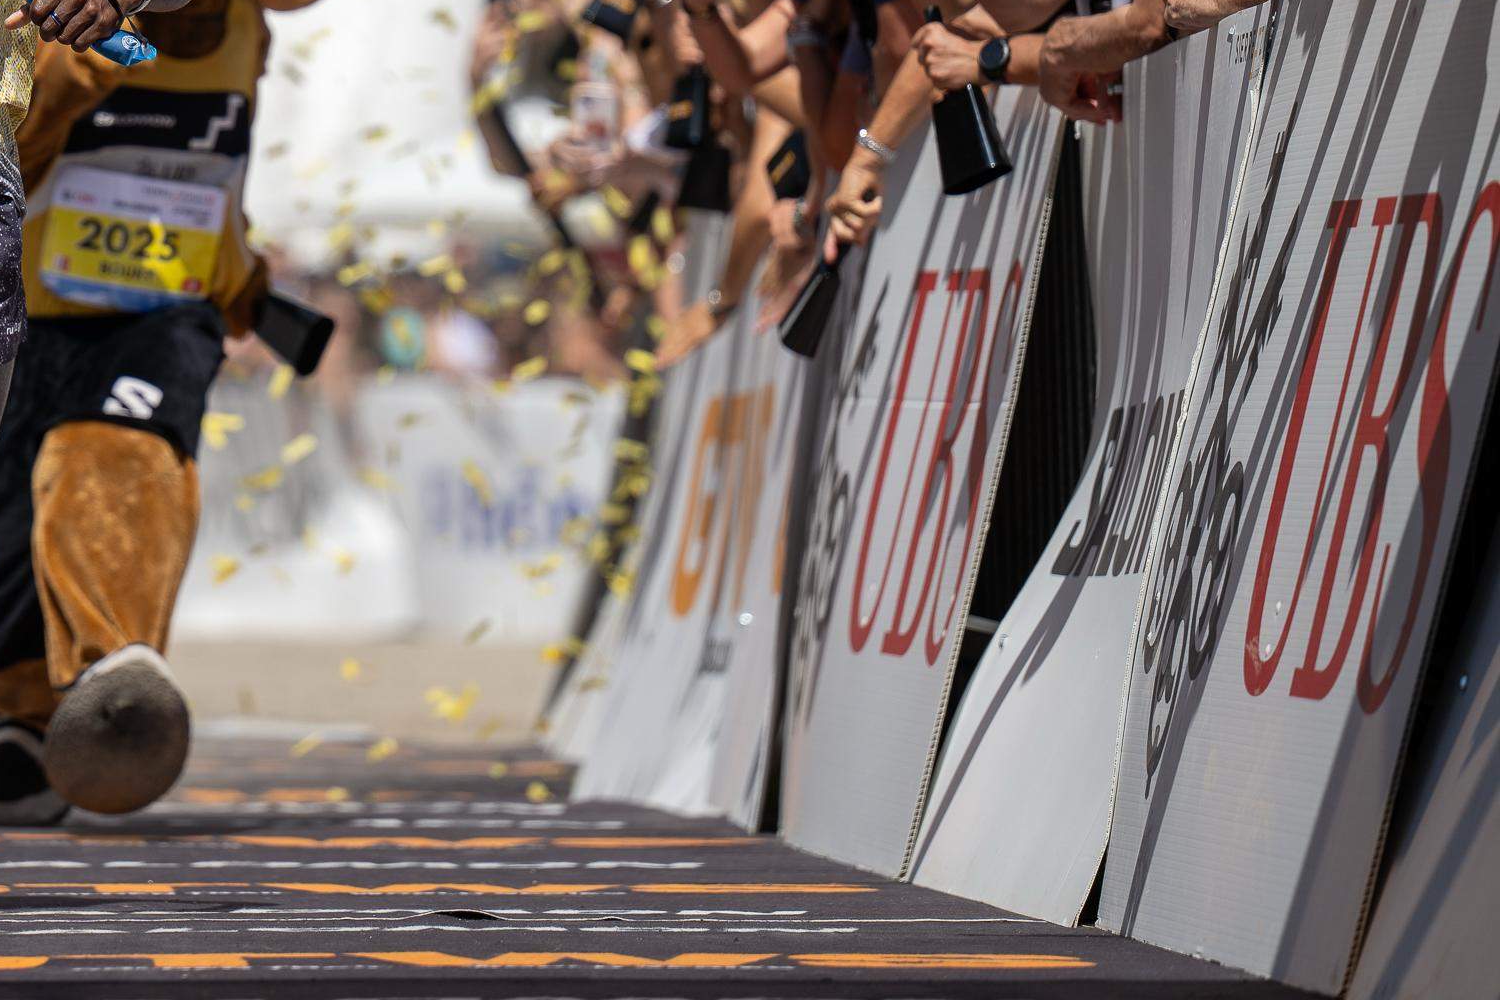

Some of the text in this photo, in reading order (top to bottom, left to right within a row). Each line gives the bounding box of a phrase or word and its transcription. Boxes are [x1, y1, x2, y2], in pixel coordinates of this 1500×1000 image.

[77, 216, 180, 262] 2025
[848, 258, 1023, 668] UBS
[1243, 179, 1500, 716] UBS
